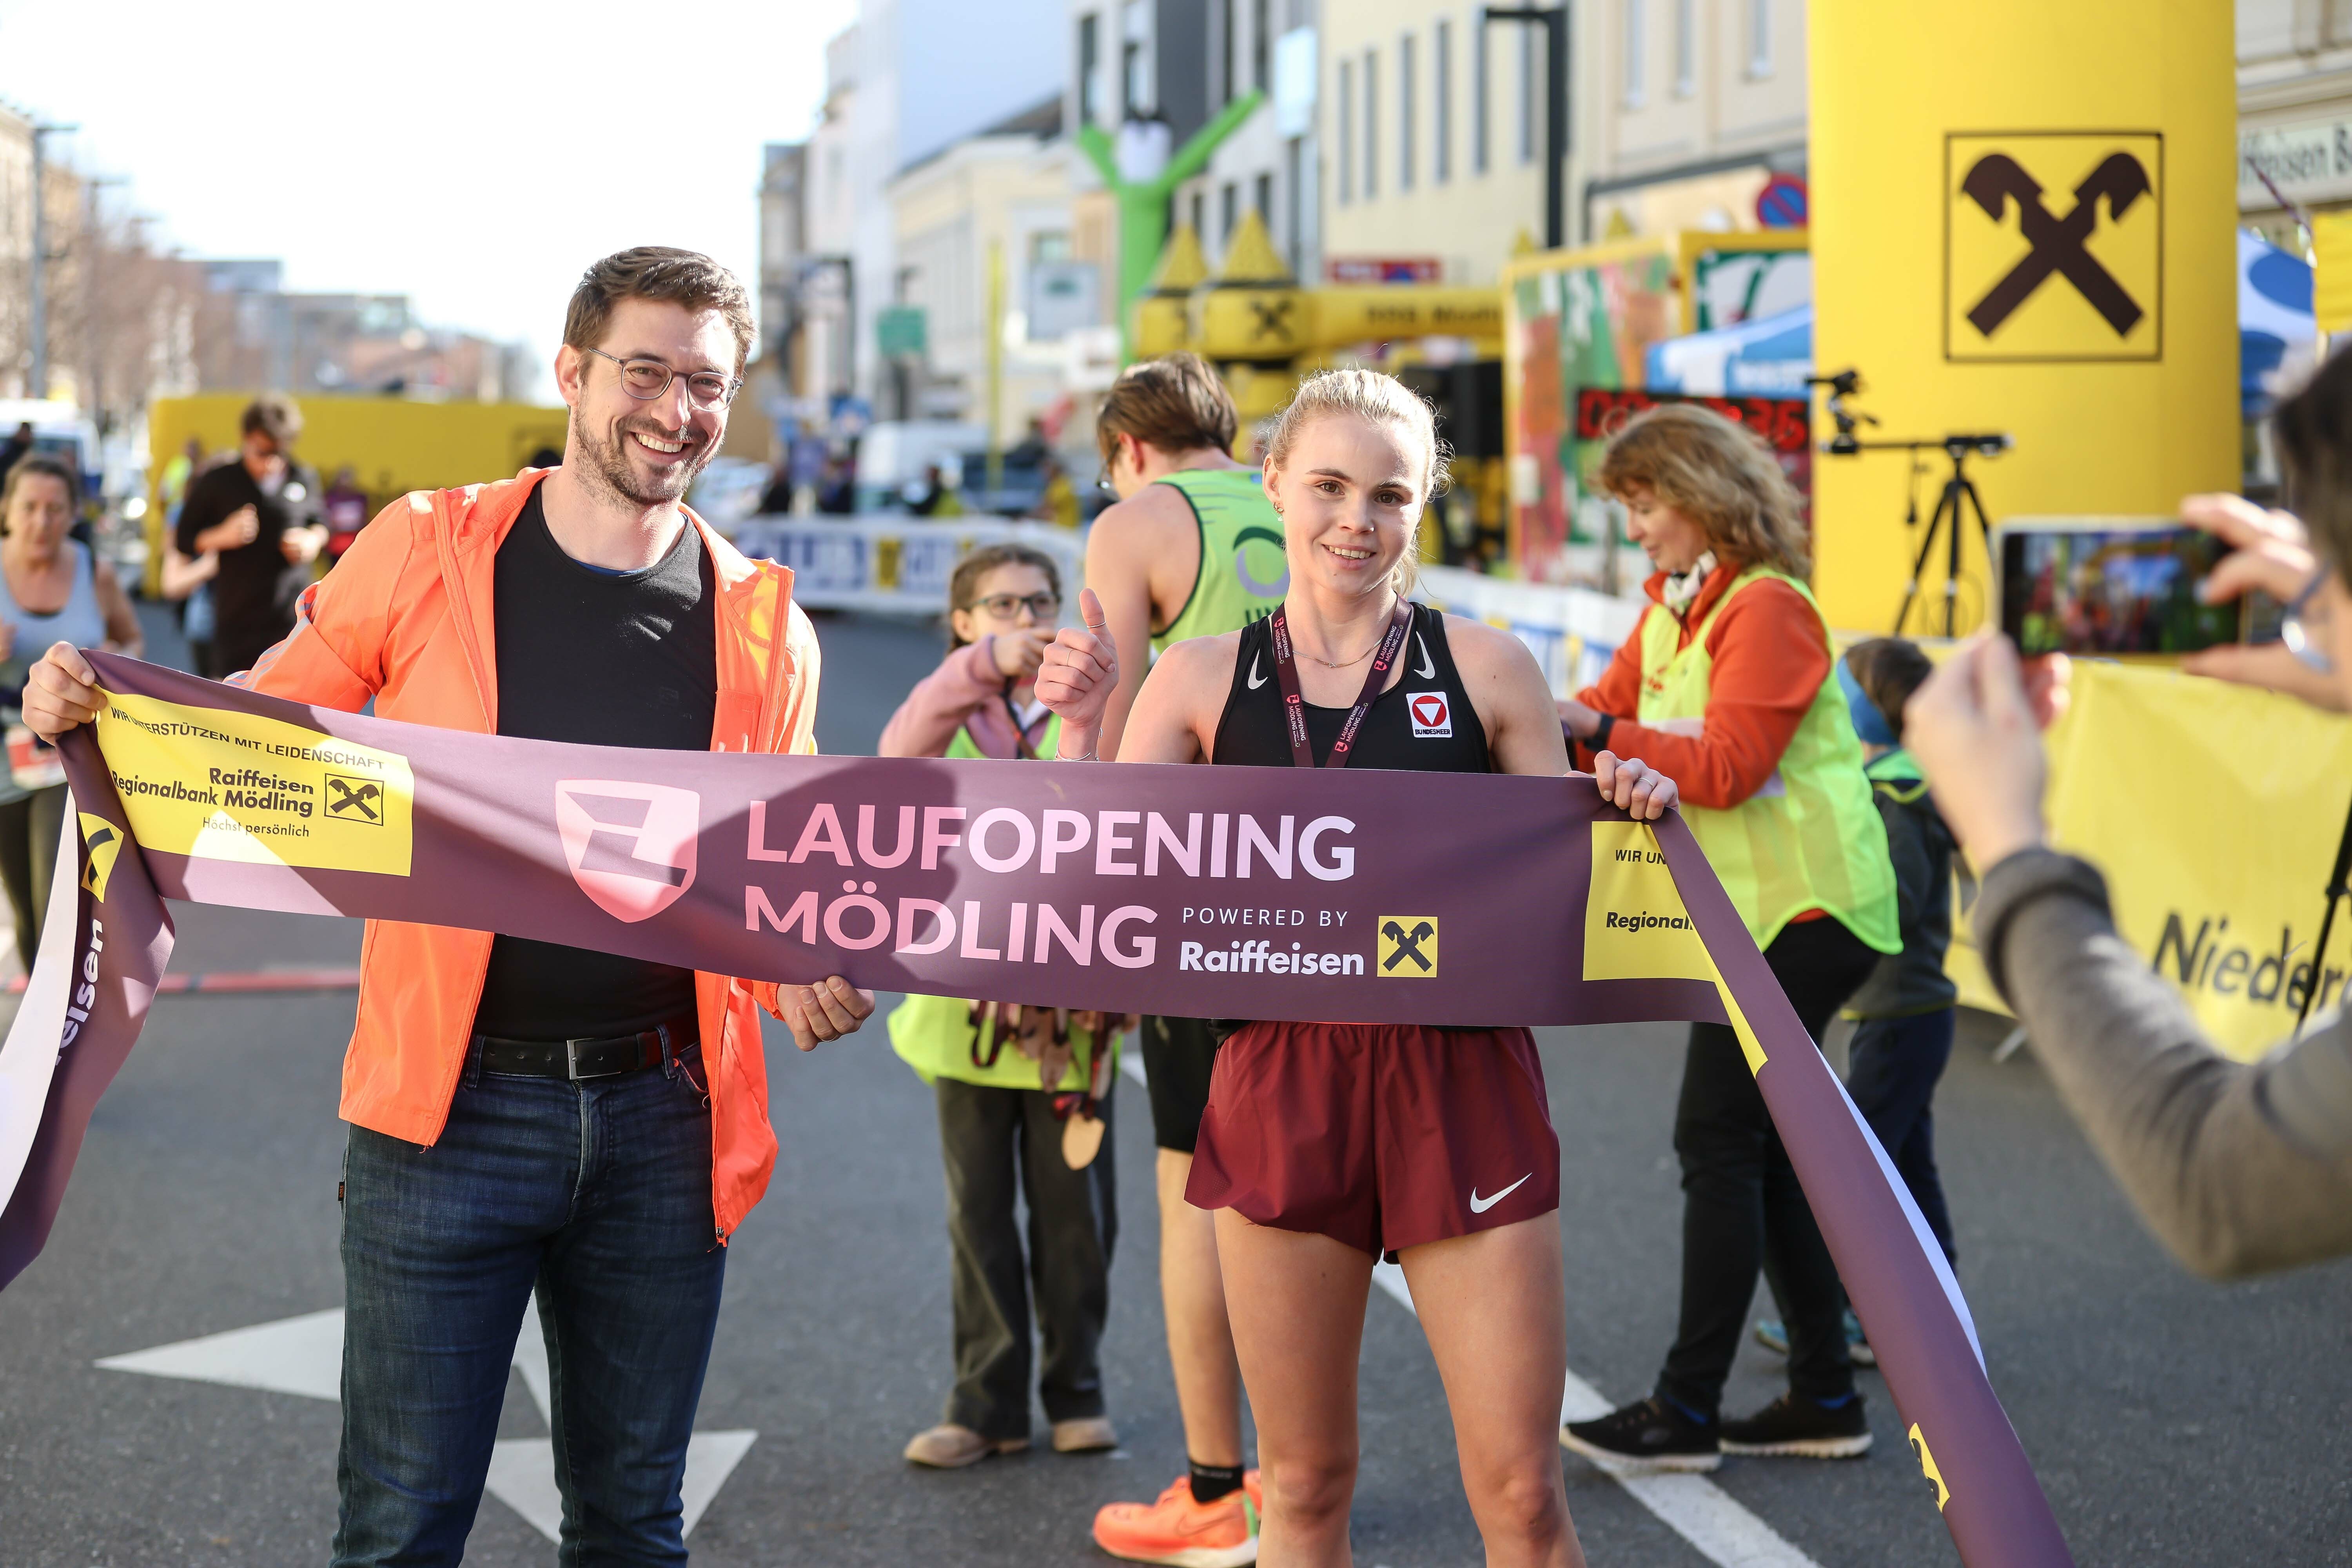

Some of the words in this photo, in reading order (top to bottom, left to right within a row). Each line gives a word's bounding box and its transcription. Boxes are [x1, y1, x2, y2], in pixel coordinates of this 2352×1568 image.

[1280, 626, 1290, 658] LAUFOPENING
[1379, 625, 1397, 659] LAUFOPENING
[1385, 639, 1398, 662] MÖDLING
[1289, 706, 1297, 730] MÖDLING
[1295, 705, 1306, 741] LAUFOPENING
[1340, 706, 1360, 740] LAUFOPENING
[1346, 717, 1361, 742] MÖDLING
[111, 706, 131, 722] WIR
[235, 737, 261, 750] MIT
[266, 743, 384, 769] LEIDENSCHAFT
[112, 770, 219, 805] Regionalbank
[224, 789, 313, 818] Mödling
[209, 768, 314, 795] Raiffeisen
[202, 817, 242, 831] Höchst
[245, 823, 310, 837] persönlich
[747, 800, 1356, 881] LAUFOPENING
[1615, 849, 1642, 862] WIR
[745, 880, 1158, 969] MÖDLING
[1182, 907, 1305, 926] POWERED
[1319, 911, 1348, 927] BY
[1606, 910, 1693, 933] Regional
[1180, 940, 1365, 975] Raiffeisen
[56, 918, 103, 1066] eisen
